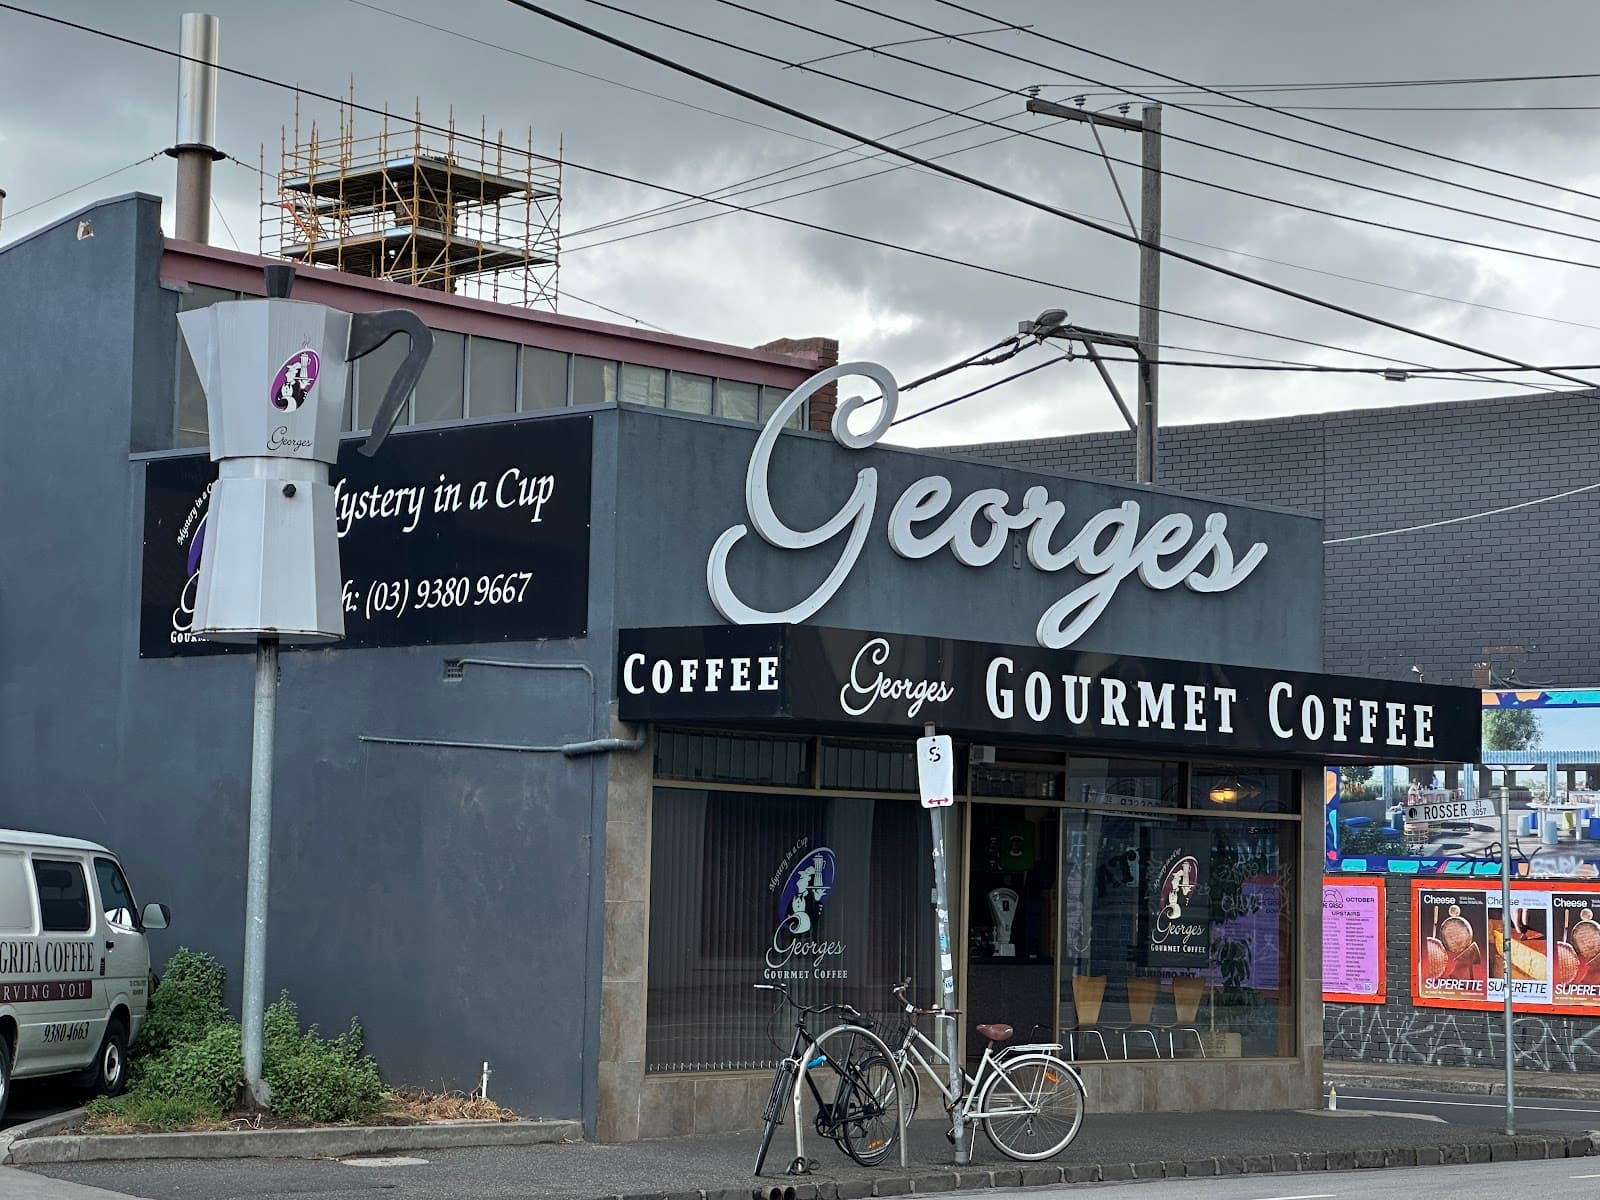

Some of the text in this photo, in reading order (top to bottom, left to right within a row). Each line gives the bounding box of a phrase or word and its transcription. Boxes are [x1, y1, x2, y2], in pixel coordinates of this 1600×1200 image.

[267, 426, 312, 452] Georges
[334, 468, 555, 538] ystery in a Cup
[706, 361, 1268, 649] Georges
[177, 506, 198, 545] Mystery
[342, 572, 533, 619] h: (03) 9380 9667
[623, 653, 779, 694] COFFEE
[840, 638, 1435, 748] Georges GOURMET COFFEE
[1424, 803, 1468, 820] ROSSER
[1472, 807, 1487, 816] 3057
[769, 860, 788, 893] Mystery
[1424, 894, 1456, 905] Cheese
[1487, 896, 1520, 906] Chese
[1554, 897, 1588, 908] Cheese
[1151, 904, 1206, 944] Georges
[765, 914, 846, 968] Georges
[1150, 943, 1206, 953] GOURMET COFFEE
[45, 941, 94, 972] COFFEE
[764, 968, 848, 979] GOURMET COFFEE
[1425, 978, 1484, 991] SUPERETTE
[59, 983, 86, 998] YOU
[43, 1022, 90, 1043] 9380 4663
